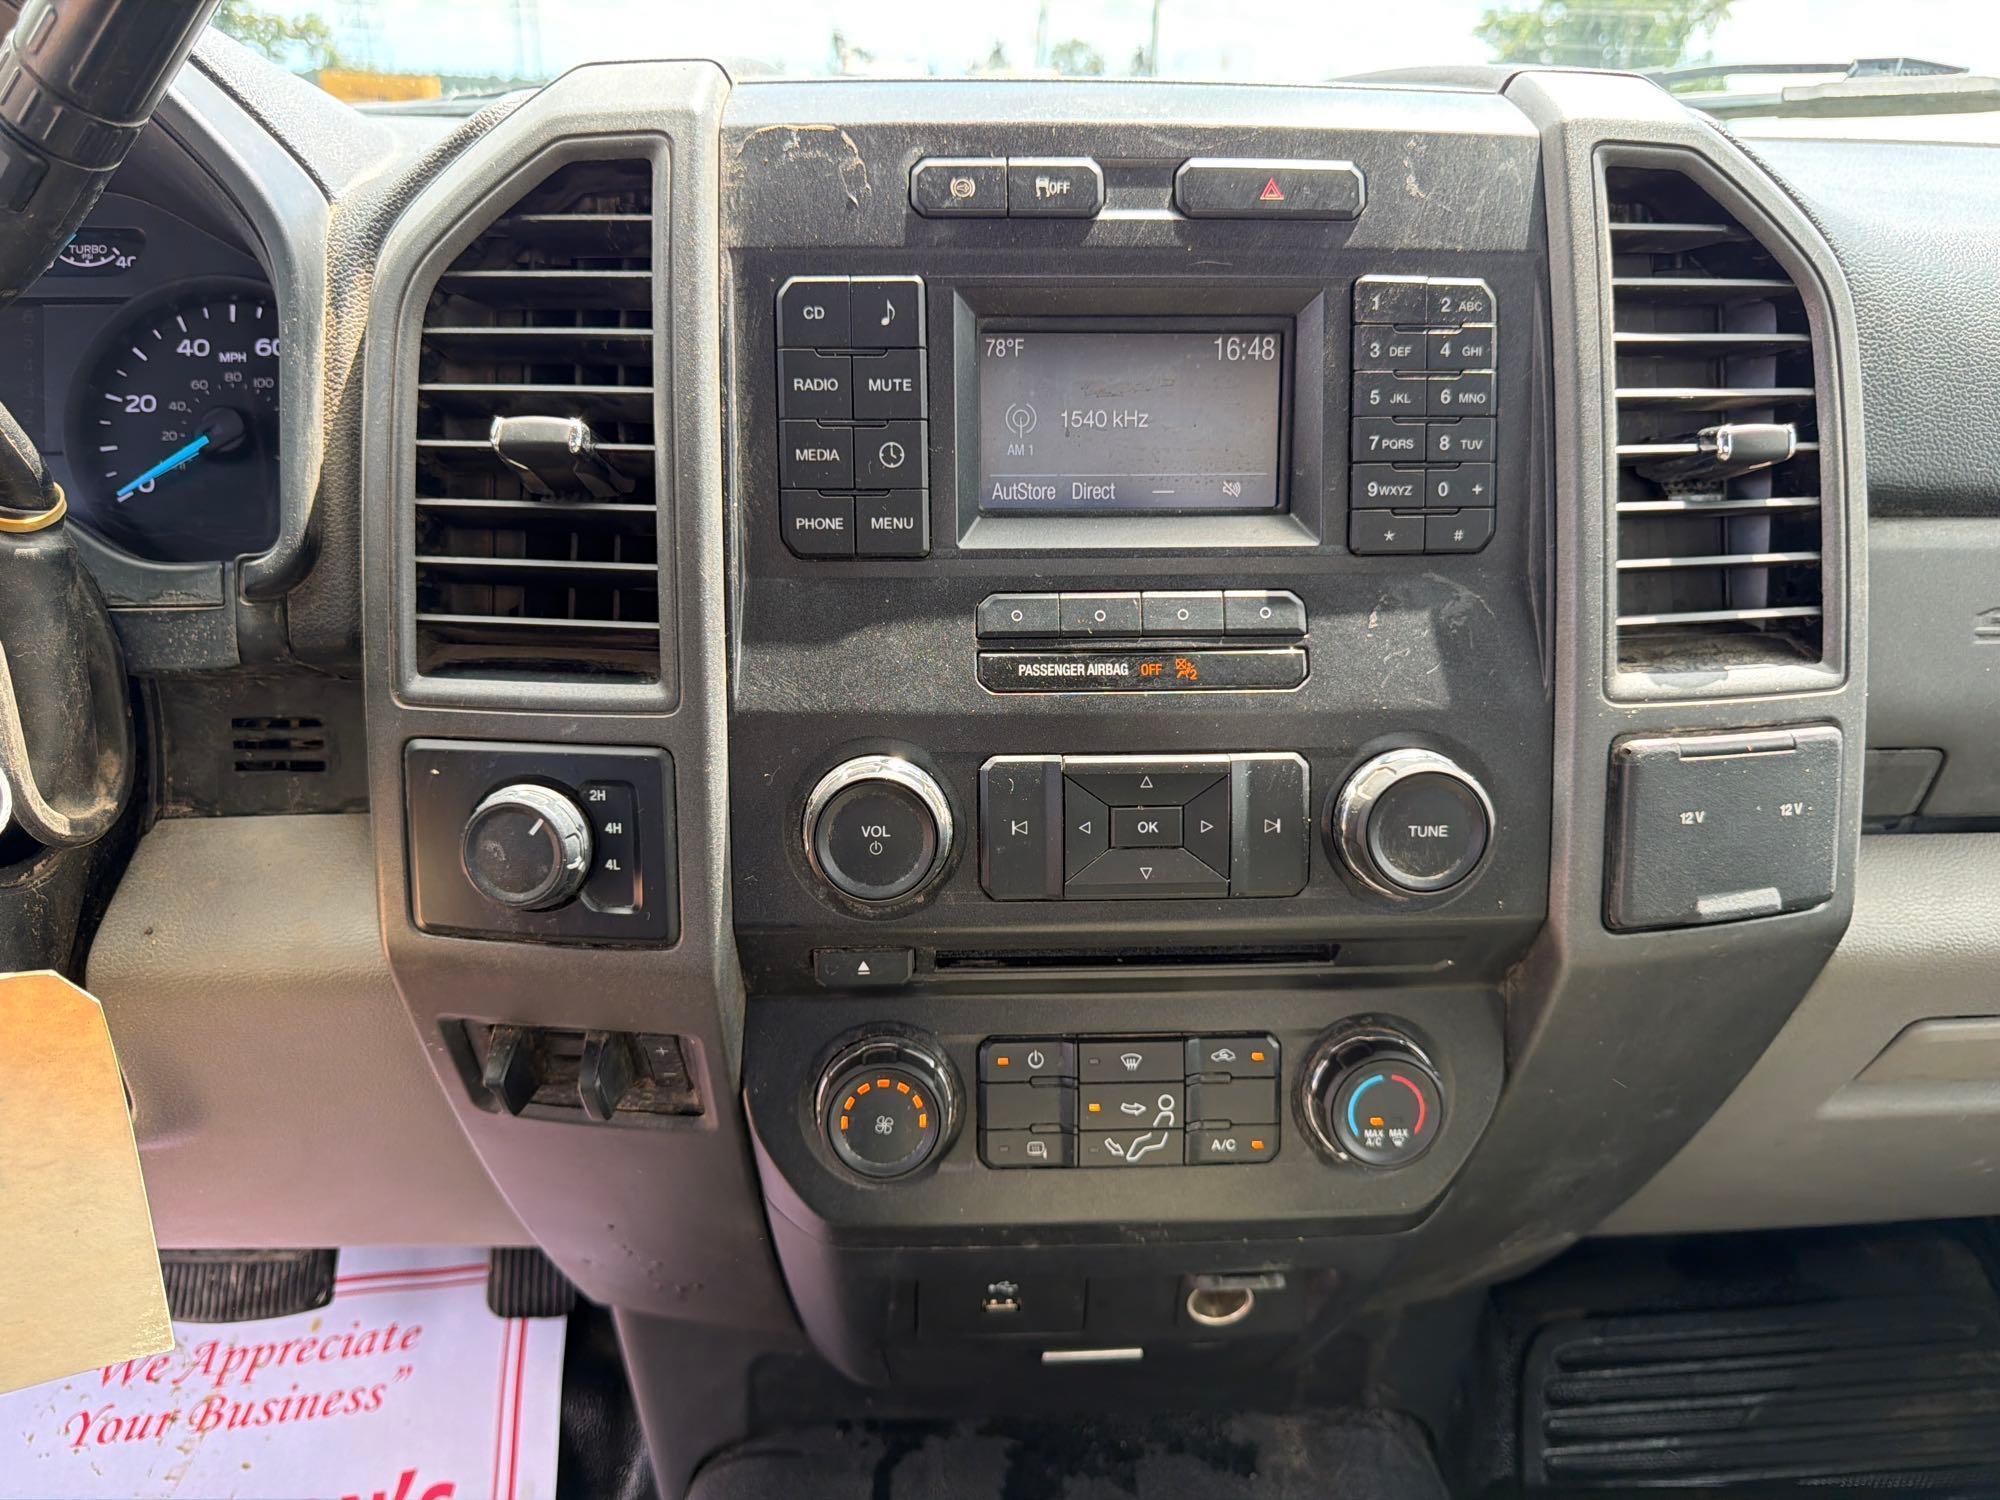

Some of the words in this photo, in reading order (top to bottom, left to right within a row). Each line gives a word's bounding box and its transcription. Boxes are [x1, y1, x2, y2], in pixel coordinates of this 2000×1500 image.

[1049, 181, 1070, 195] OFF
[68, 245, 107, 254] TURBO
[1440, 296, 1452, 313] 2
[1458, 301, 1483, 313] ABC
[803, 306, 825, 320] CD
[176, 339, 211, 357] 40
[985, 338, 1025, 358] 78°F
[1213, 336, 1276, 361] 16:48
[1369, 342, 1380, 358] 3
[1389, 346, 1412, 358] DEF
[1439, 342, 1451, 358] 4
[1462, 346, 1483, 357] GHI
[219, 351, 247, 363] MPH
[224, 371, 242, 382] 80
[253, 378, 274, 388] 100
[190, 380, 209, 390] 60
[794, 378, 839, 392] RADIO
[868, 378, 912, 392] MUTE
[125, 394, 157, 413] 20
[1369, 389, 1380, 405] 5
[1389, 393, 1411, 404] JKL
[1440, 388, 1451, 405] 6
[1458, 393, 1486, 404] MNO
[168, 401, 187, 411] 40
[1060, 409, 1107, 429] 1540
[1112, 409, 1150, 429] kHz
[161, 431, 178, 441] 20
[1368, 435, 1379, 451] 7
[1381, 439, 1414, 450] PQRS
[1439, 435, 1450, 451] 8
[1460, 439, 1483, 450] TUV
[795, 448, 840, 462] MEDIA
[1007, 444, 1025, 456] AM
[991, 482, 1056, 500] AutStore
[1072, 482, 1116, 500] Direct
[1367, 481, 1378, 497] 9
[1378, 485, 1413, 496] WXYZ
[1437, 481, 1448, 497] 0
[796, 517, 844, 530] PHONE
[871, 517, 914, 530] MENU
[1018, 663, 1085, 677] PASSENGER
[1087, 663, 1129, 676] AIRBAG
[1140, 663, 1163, 676] OFF
[589, 789, 606, 801] 2H
[604, 823, 622, 834] 4H
[861, 825, 891, 838] VOL
[1137, 821, 1159, 834] OK
[1408, 825, 1448, 838] TUNE
[604, 860, 621, 871] 4L
[1364, 1129, 1384, 1138] MAX
[1388, 1128, 1408, 1138] MAX
[1211, 1138, 1237, 1152] A/C
[1365, 1138, 1382, 1147] A/C
[171, 1320, 424, 1390] Appreciate
[64, 1403, 181, 1449] Your
